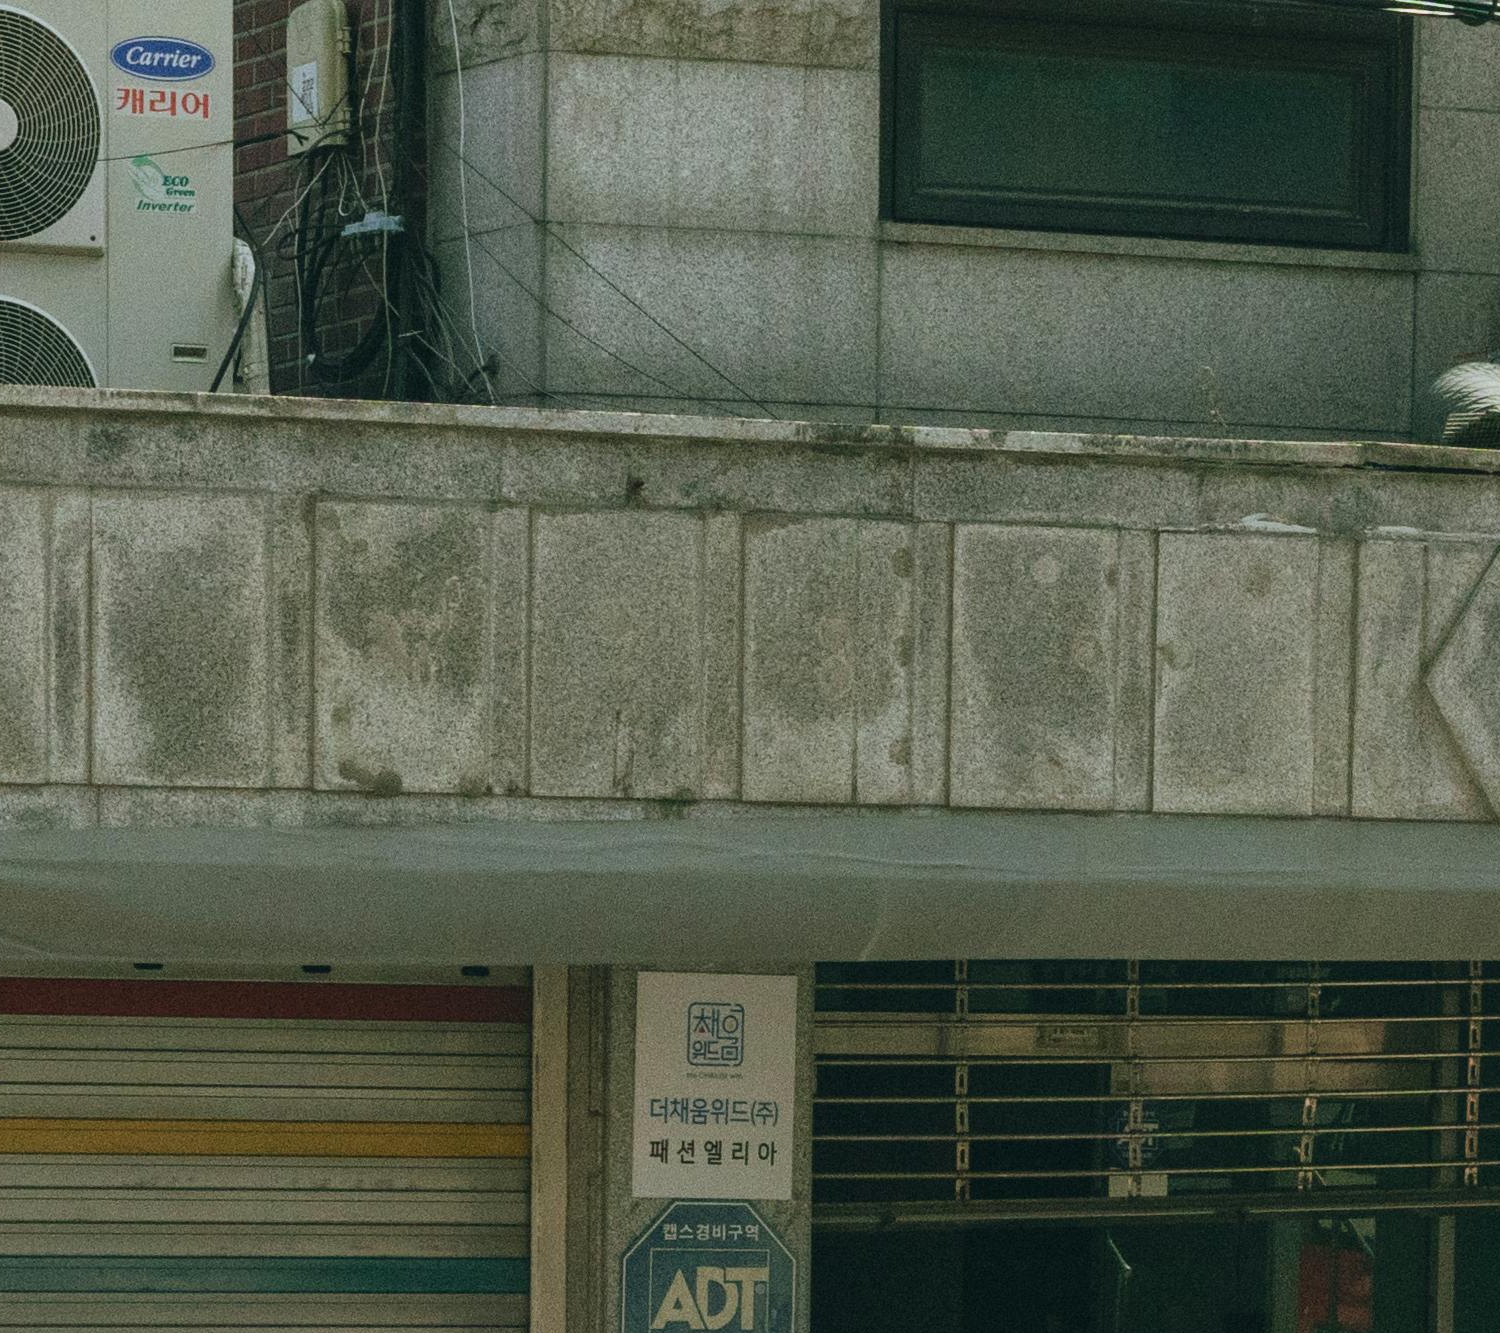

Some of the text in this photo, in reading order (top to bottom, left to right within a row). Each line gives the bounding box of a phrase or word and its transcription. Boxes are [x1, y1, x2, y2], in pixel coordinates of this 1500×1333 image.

[126, 46, 202, 69] Carrier
[116, 88, 209, 119] 캐리어
[162, 175, 189, 186] ECO
[166, 187, 195, 197] Green
[137, 199, 195, 213] Inverter
[649, 1098, 778, 1128] 더채움위드(주)
[662, 1223, 760, 1242] 캡스경비구역
[650, 1267, 769, 1330] ADT
